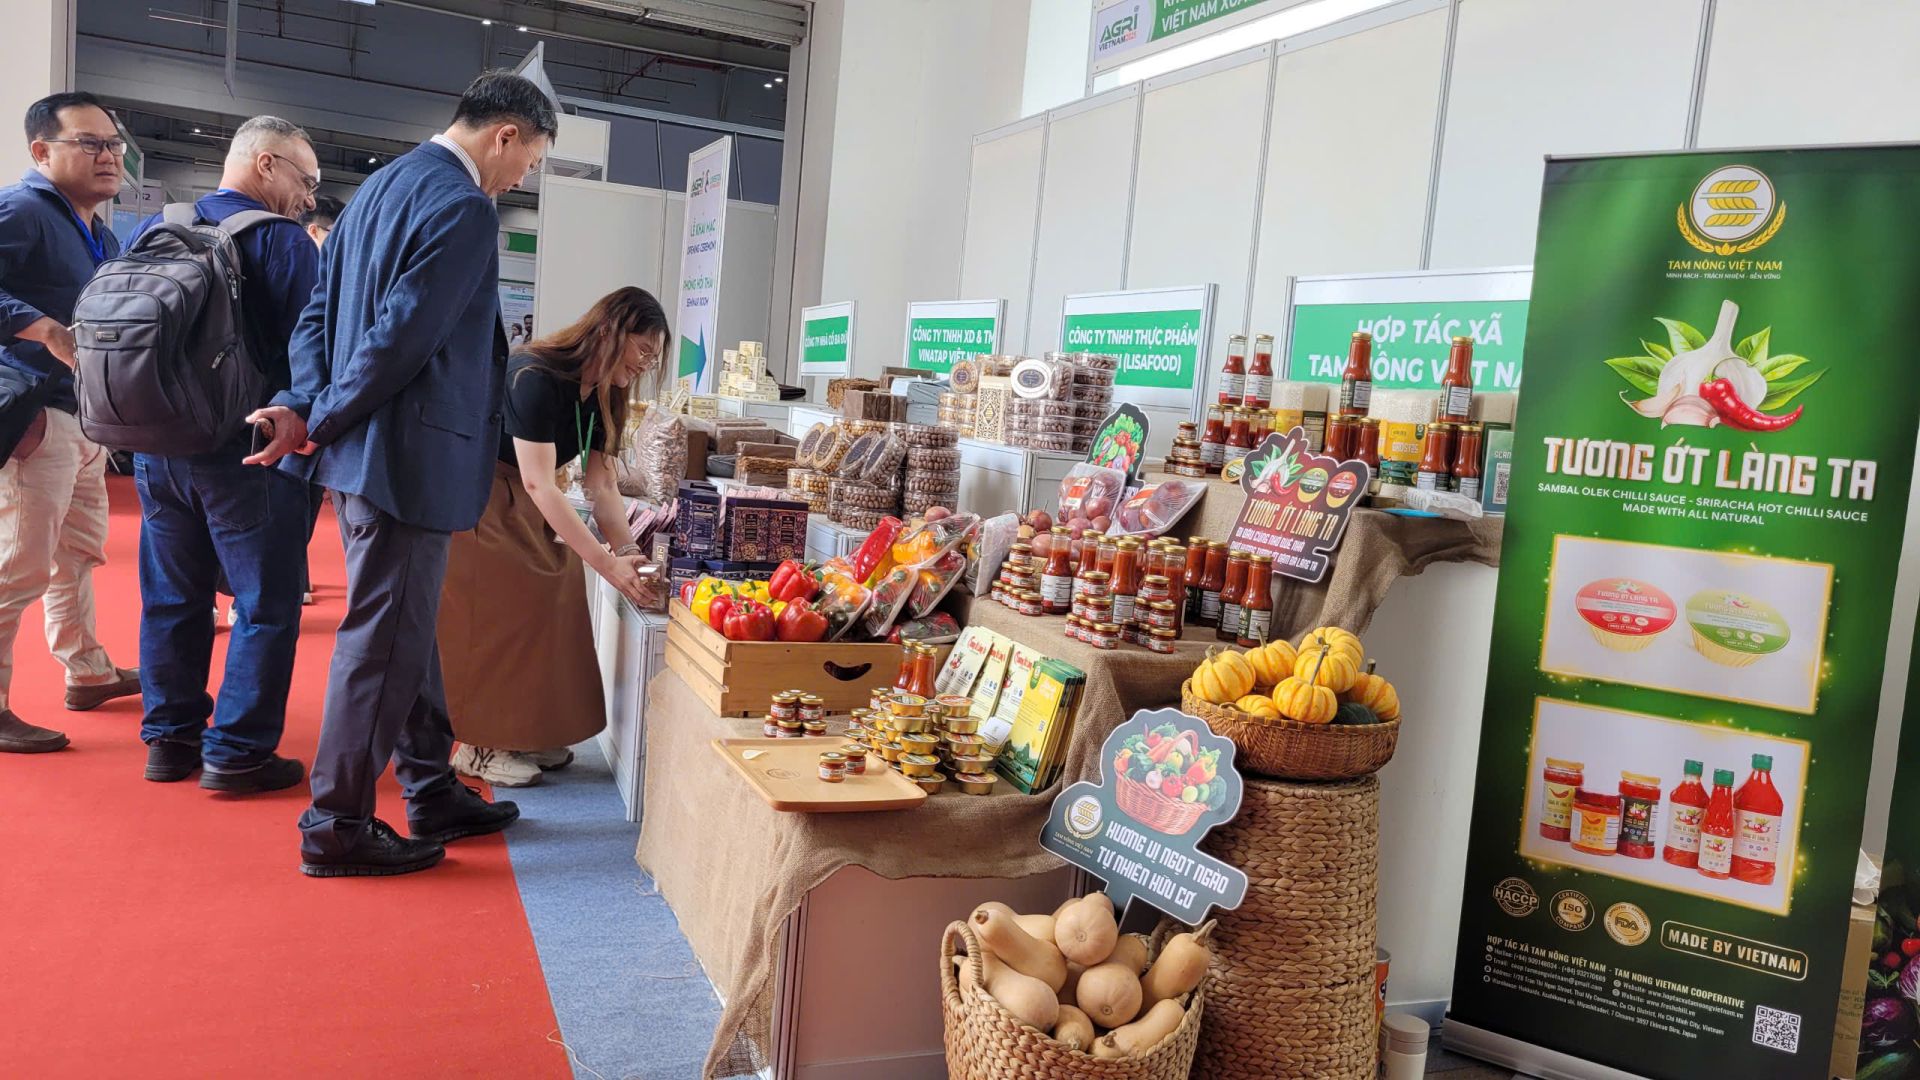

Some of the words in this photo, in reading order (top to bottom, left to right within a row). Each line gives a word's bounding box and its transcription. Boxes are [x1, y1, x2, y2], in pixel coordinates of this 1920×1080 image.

[1101, 12, 1138, 42] AGRI
[1162, 11, 1187, 33] VIỆT
[1189, 1, 1217, 21] NAM
[1667, 260, 1691, 270] TAM
[1693, 259, 1725, 270] NÔNG
[1728, 259, 1753, 272] VIỆT
[1755, 260, 1783, 271] NAM
[912, 325, 932, 342] CÔNG
[932, 329, 942, 342] TY
[942, 329, 962, 343] TNHH
[963, 329, 975, 343] XD
[976, 329, 982, 343] &
[1068, 326, 1092, 345] CÔNG
[1094, 329, 1106, 345] TY
[1107, 329, 1133, 345] TNHH
[1135, 326, 1163, 349] THỰC
[1164, 321, 1200, 346] PHẨM
[1357, 315, 1406, 349] HỢP
[1412, 312, 1461, 345] TÁC
[1468, 313, 1503, 345] XÃ
[918, 348, 948, 363] VINATAP
[949, 347, 966, 363] VIỆT
[1123, 353, 1181, 376] (LISAFOOD)
[1308, 354, 1350, 378] TAM
[1370, 352, 1424, 383] ÔNG
[1431, 358, 1488, 386] VT
[1543, 435, 1655, 482] TƯƠNG
[1662, 437, 1710, 485] ỚT
[1715, 441, 1818, 496] LÀNG
[1828, 457, 1878, 501] TA
[1537, 482, 1579, 496] SAMBAL
[1581, 486, 1611, 499] OLEK
[1612, 489, 1648, 503] CHILLI
[1649, 492, 1686, 506] SAUCE
[1696, 497, 1755, 512] SRIRACHA
[1758, 502, 1784, 515] HOT
[1785, 504, 1825, 519] CHILLI
[1826, 509, 1868, 523] SAUCE
[1622, 503, 1656, 516] MADE
[1656, 505, 1686, 518] WITH
[1687, 507, 1709, 520] ALL
[1710, 509, 1765, 525] NATURAL
[1243, 498, 1281, 529] TƯƠNG
[1276, 502, 1297, 532] ỚT
[1291, 505, 1323, 537] LÀNG
[1318, 513, 1339, 541] TA
[1105, 820, 1148, 853] HƯƠNG
[1145, 842, 1161, 864] VỊ
[1159, 846, 1195, 876] NGỌT
[1193, 867, 1229, 895] NGÀO
[1096, 845, 1115, 871] TỰ
[1113, 855, 1150, 886] NHIÊN
[1149, 870, 1174, 900] HỮU
[1175, 887, 1198, 910] CƠ
[1495, 887, 1538, 906] HACCP
[1558, 891, 1588, 905] CERTIFIED
[1563, 902, 1583, 913] ISO
[1555, 915, 1586, 930] COMPANY
[1615, 916, 1639, 931] FDA
[1668, 928, 1709, 950] MADE
[1712, 939, 1732, 956] BY
[1737, 944, 1801, 974] VIETNAM
[1487, 935, 1503, 946] HỢP
[1504, 938, 1519, 949] TÁC
[1531, 946, 1547, 957] TAM
[1548, 949, 1570, 964] NÔNG
[1571, 955, 1588, 968] VIỆT
[1589, 960, 1607, 973] NAM
[1614, 967, 1630, 979] TAM
[1631, 973, 1653, 985] NONG
[1655, 978, 1689, 994] VIETNAM
[1690, 987, 1745, 1009] COOPERATIVE
